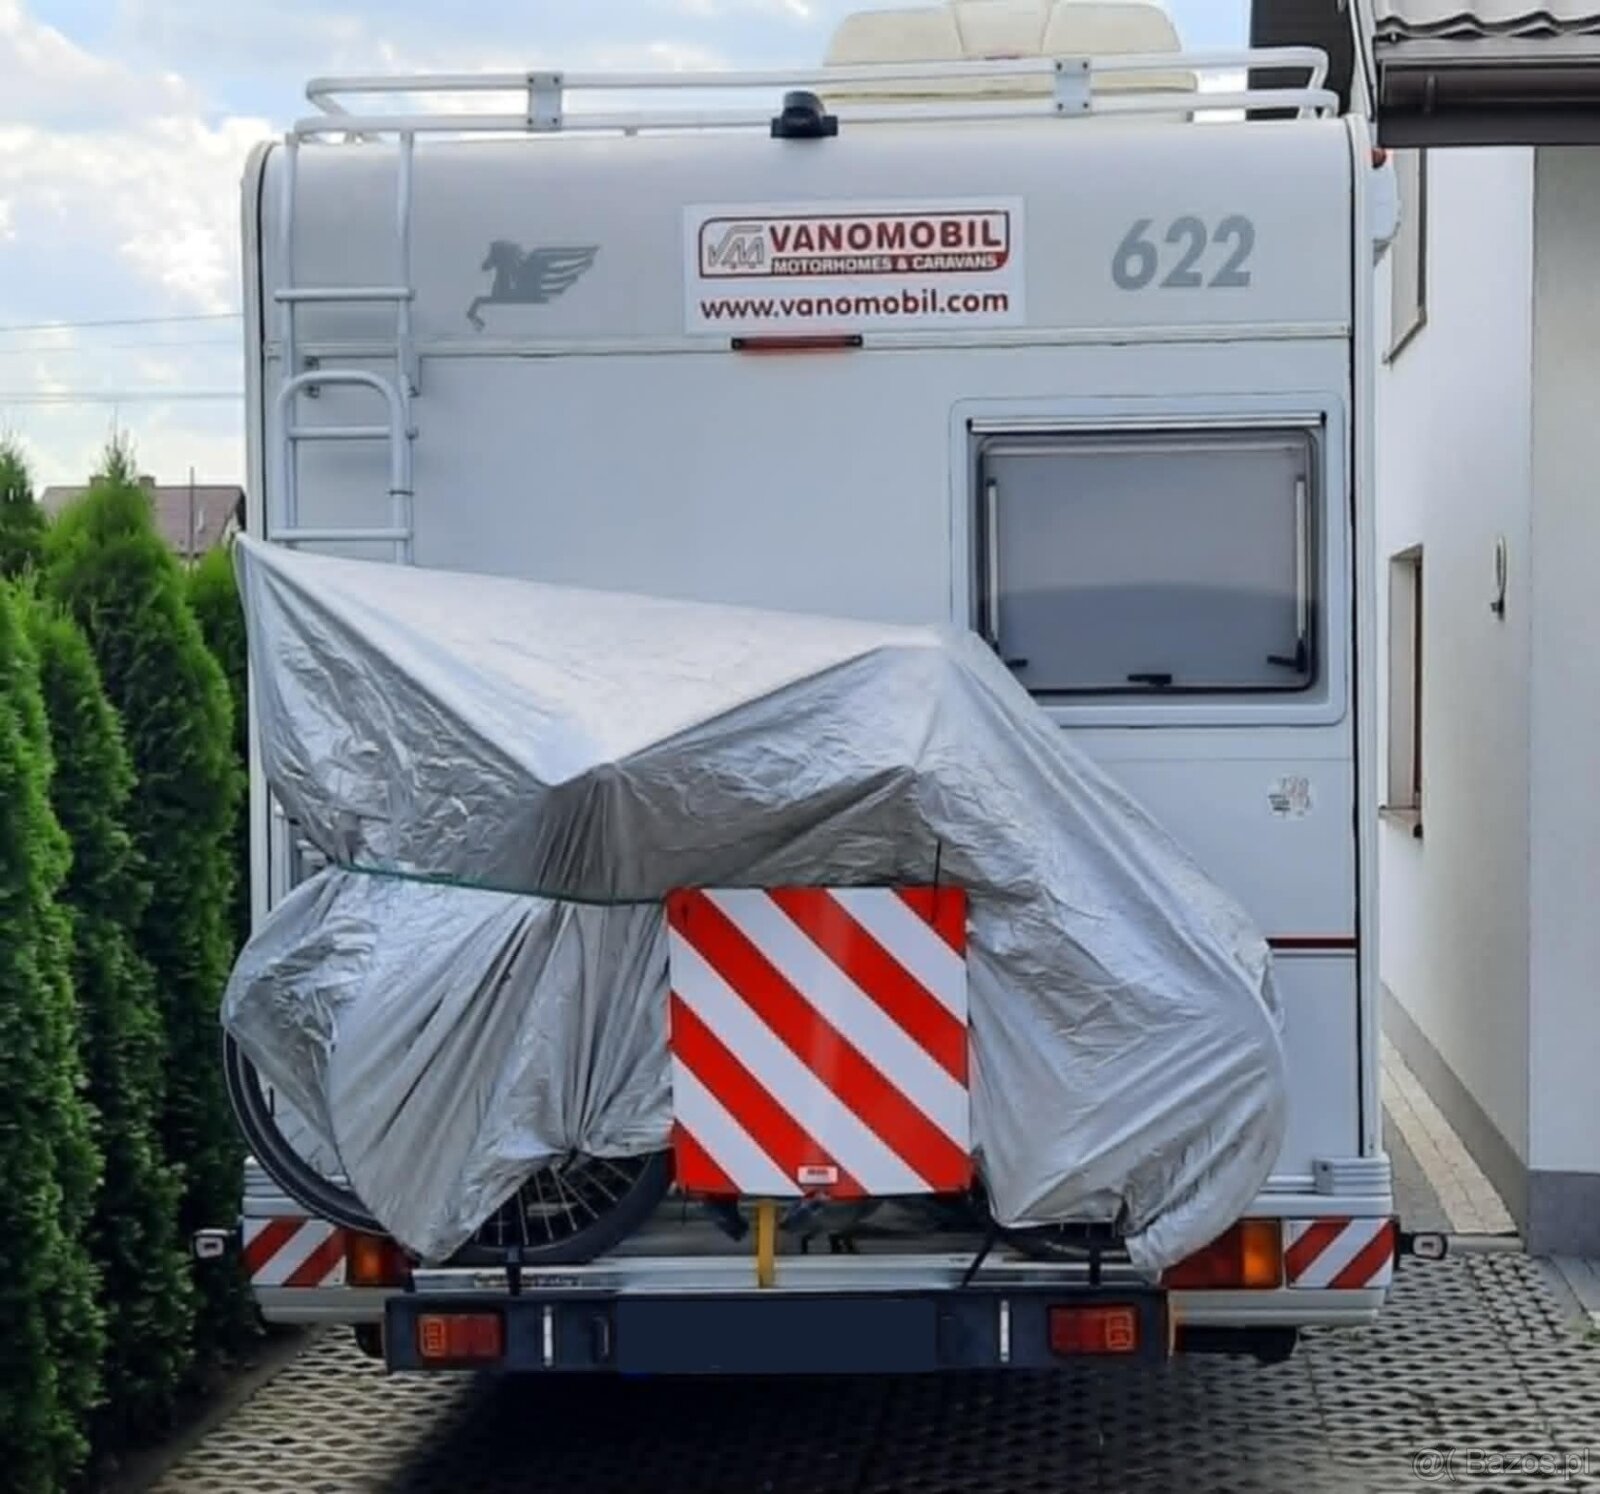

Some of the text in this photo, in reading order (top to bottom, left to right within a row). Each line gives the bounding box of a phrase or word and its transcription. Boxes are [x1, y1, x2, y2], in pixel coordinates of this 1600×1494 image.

[769, 219, 1002, 253] VANOMOBIL
[773, 253, 997, 274] MOTORHOMES & CARAVANS
[1111, 214, 1256, 291] 622
[700, 289, 1009, 319] www.vanomobil.com
